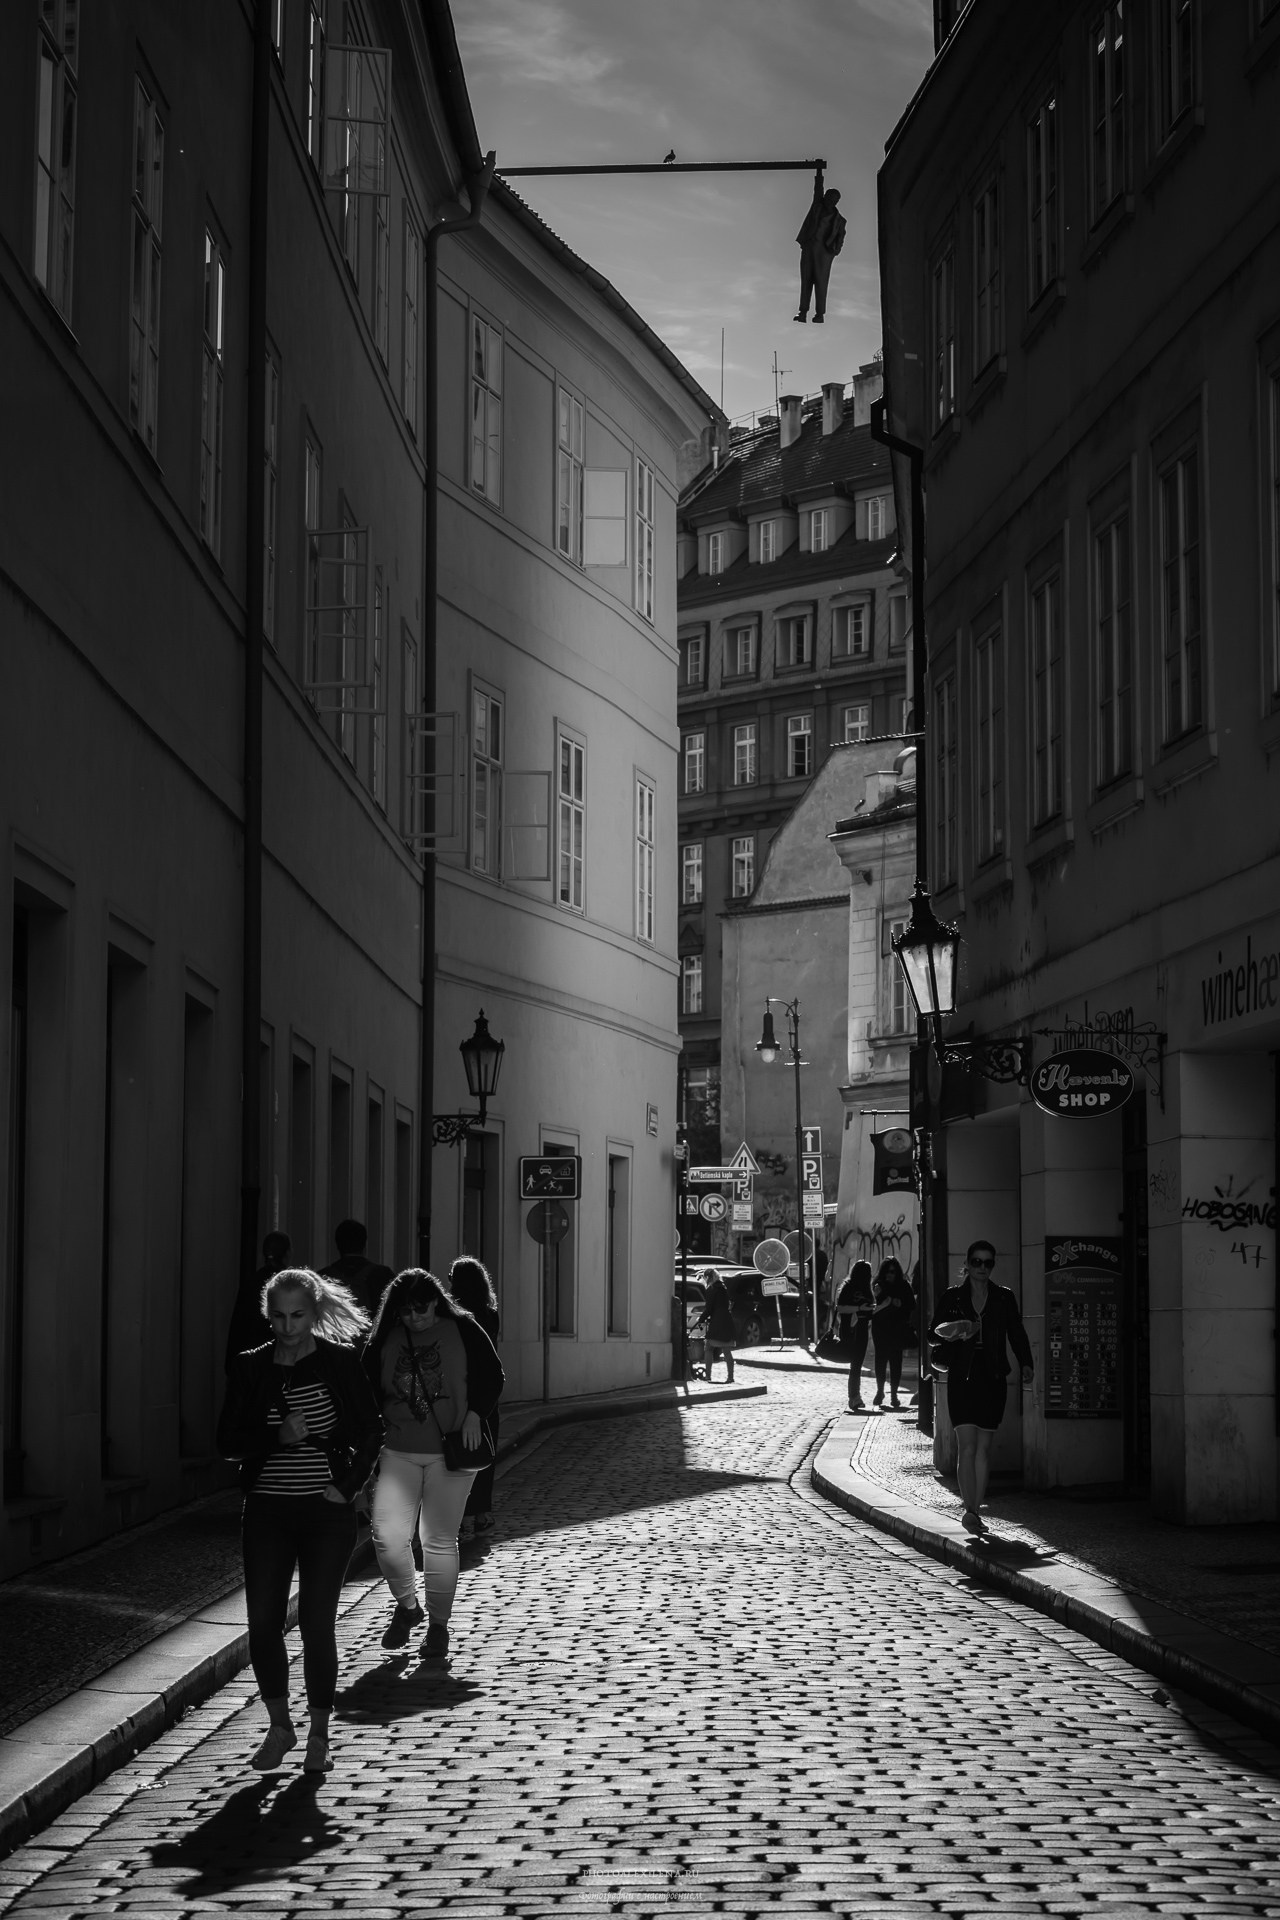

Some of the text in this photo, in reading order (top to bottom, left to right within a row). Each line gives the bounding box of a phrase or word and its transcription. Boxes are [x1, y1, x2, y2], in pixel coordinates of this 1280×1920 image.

[1202, 935, 1280, 1026] winehæ
[1059, 1093, 1111, 1107] SHOP
[803, 1159, 817, 1181] P
[1053, 1272, 1076, 1284] 0%
[1069, 1327, 1089, 1335] 15.00
[1073, 1335, 1090, 1343] 3.00
